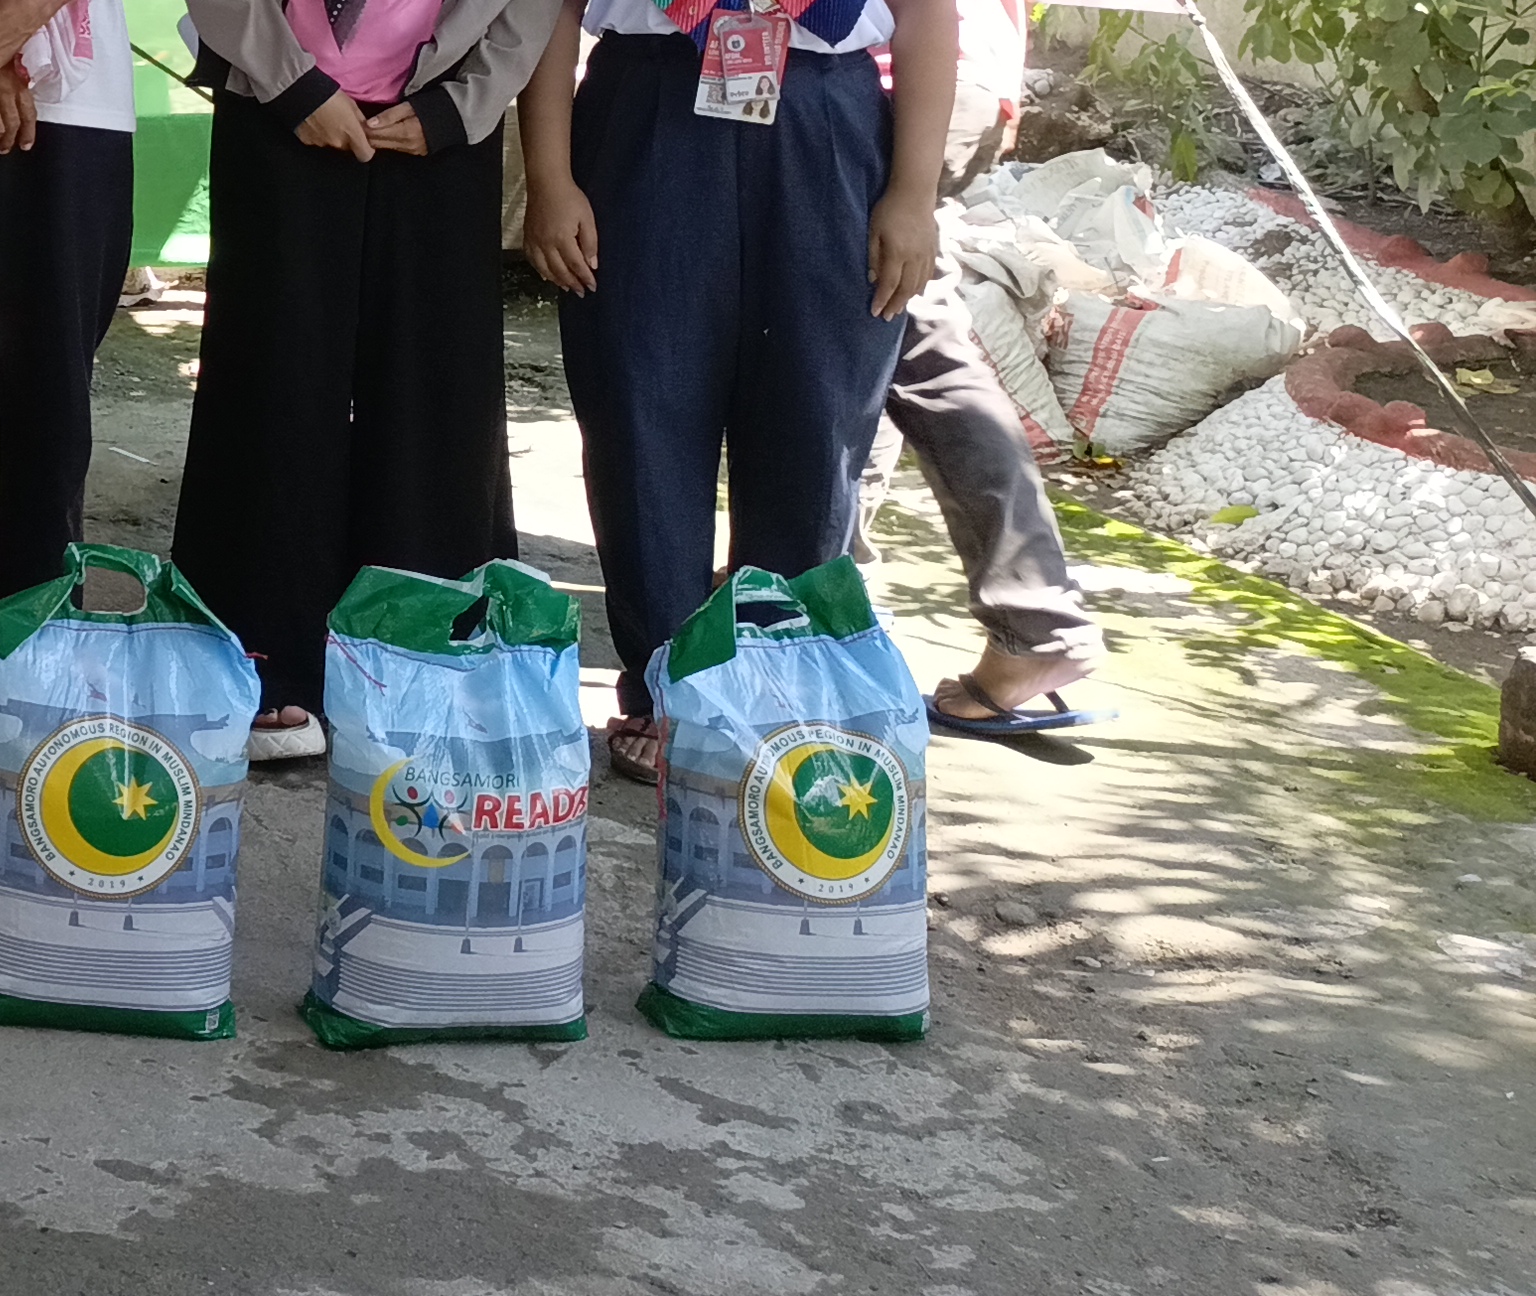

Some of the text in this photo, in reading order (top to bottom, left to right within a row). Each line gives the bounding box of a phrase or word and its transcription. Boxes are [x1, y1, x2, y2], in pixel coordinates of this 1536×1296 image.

[857, 740, 872, 755] IN
[874, 748, 903, 791] MUSLIM
[24, 722, 194, 863] BANGSAMORO AUTONOMOUS REGION IN MUSLIM MINDANAO
[473, 788, 576, 830] READ
[748, 783, 784, 871] BANGSAMORO
[886, 794, 907, 860] MINDANAO
[87, 877, 126, 889] 2019
[818, 882, 854, 894] 2019
